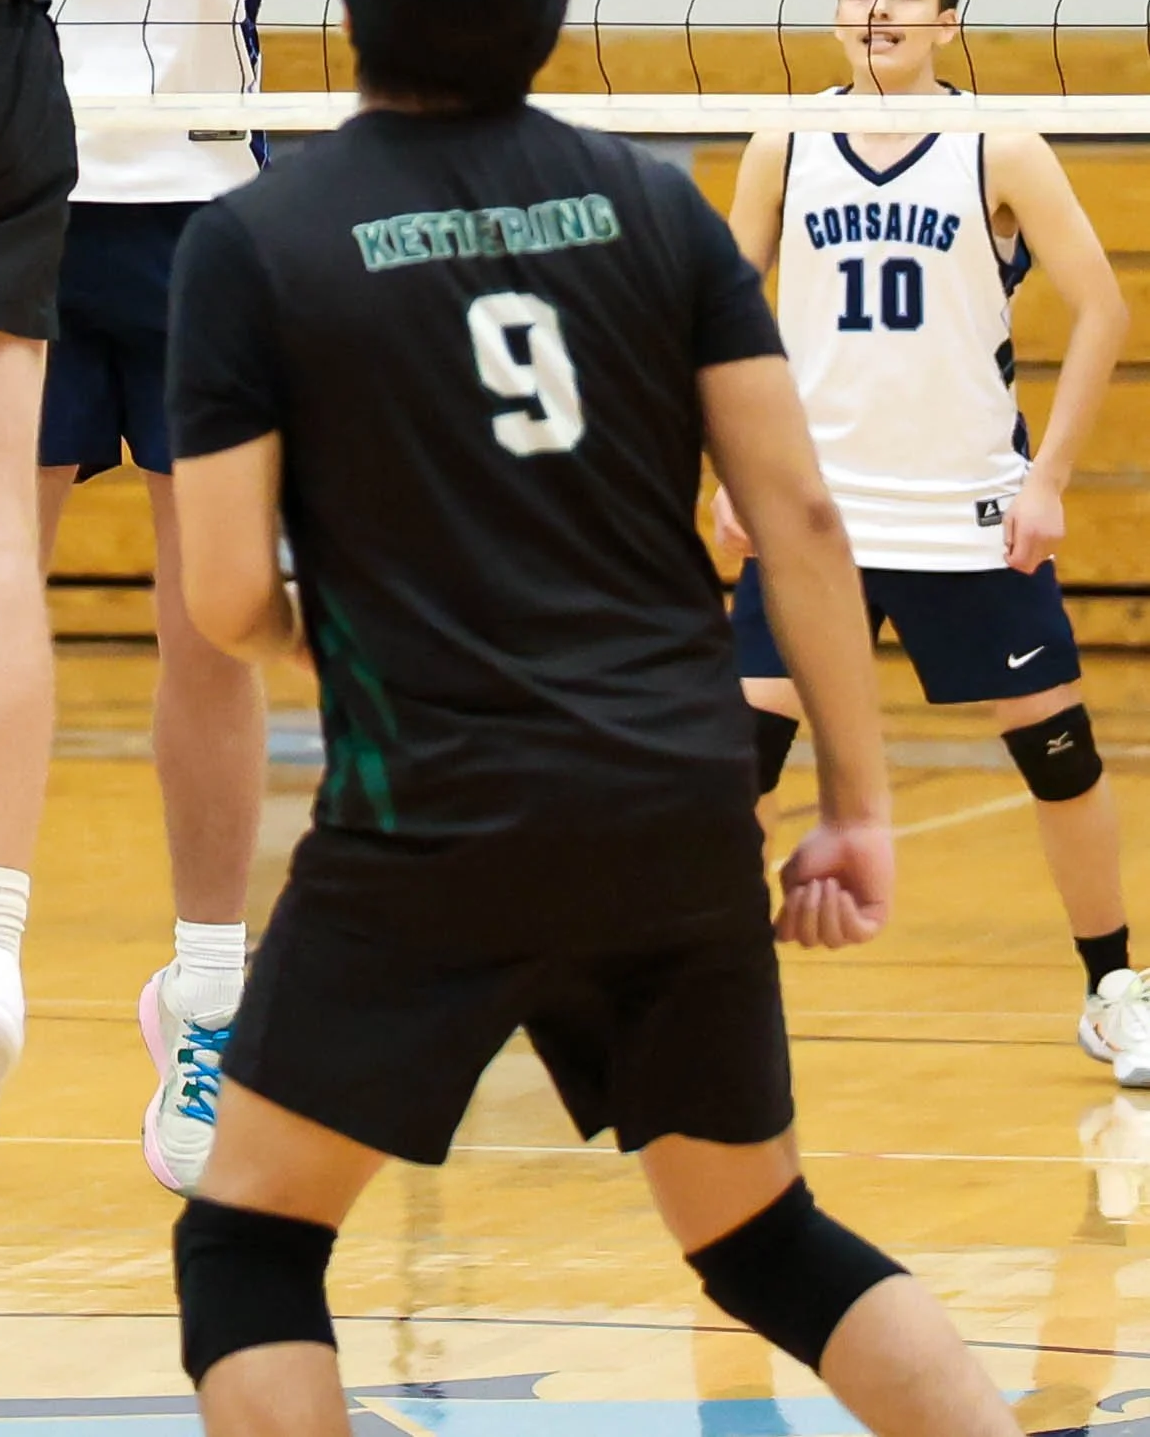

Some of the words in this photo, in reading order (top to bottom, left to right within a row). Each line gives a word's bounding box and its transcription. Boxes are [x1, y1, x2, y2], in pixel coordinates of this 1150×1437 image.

[804, 201, 962, 253] CORSAIRS
[836, 256, 925, 333] 10
[466, 291, 586, 457] 9
